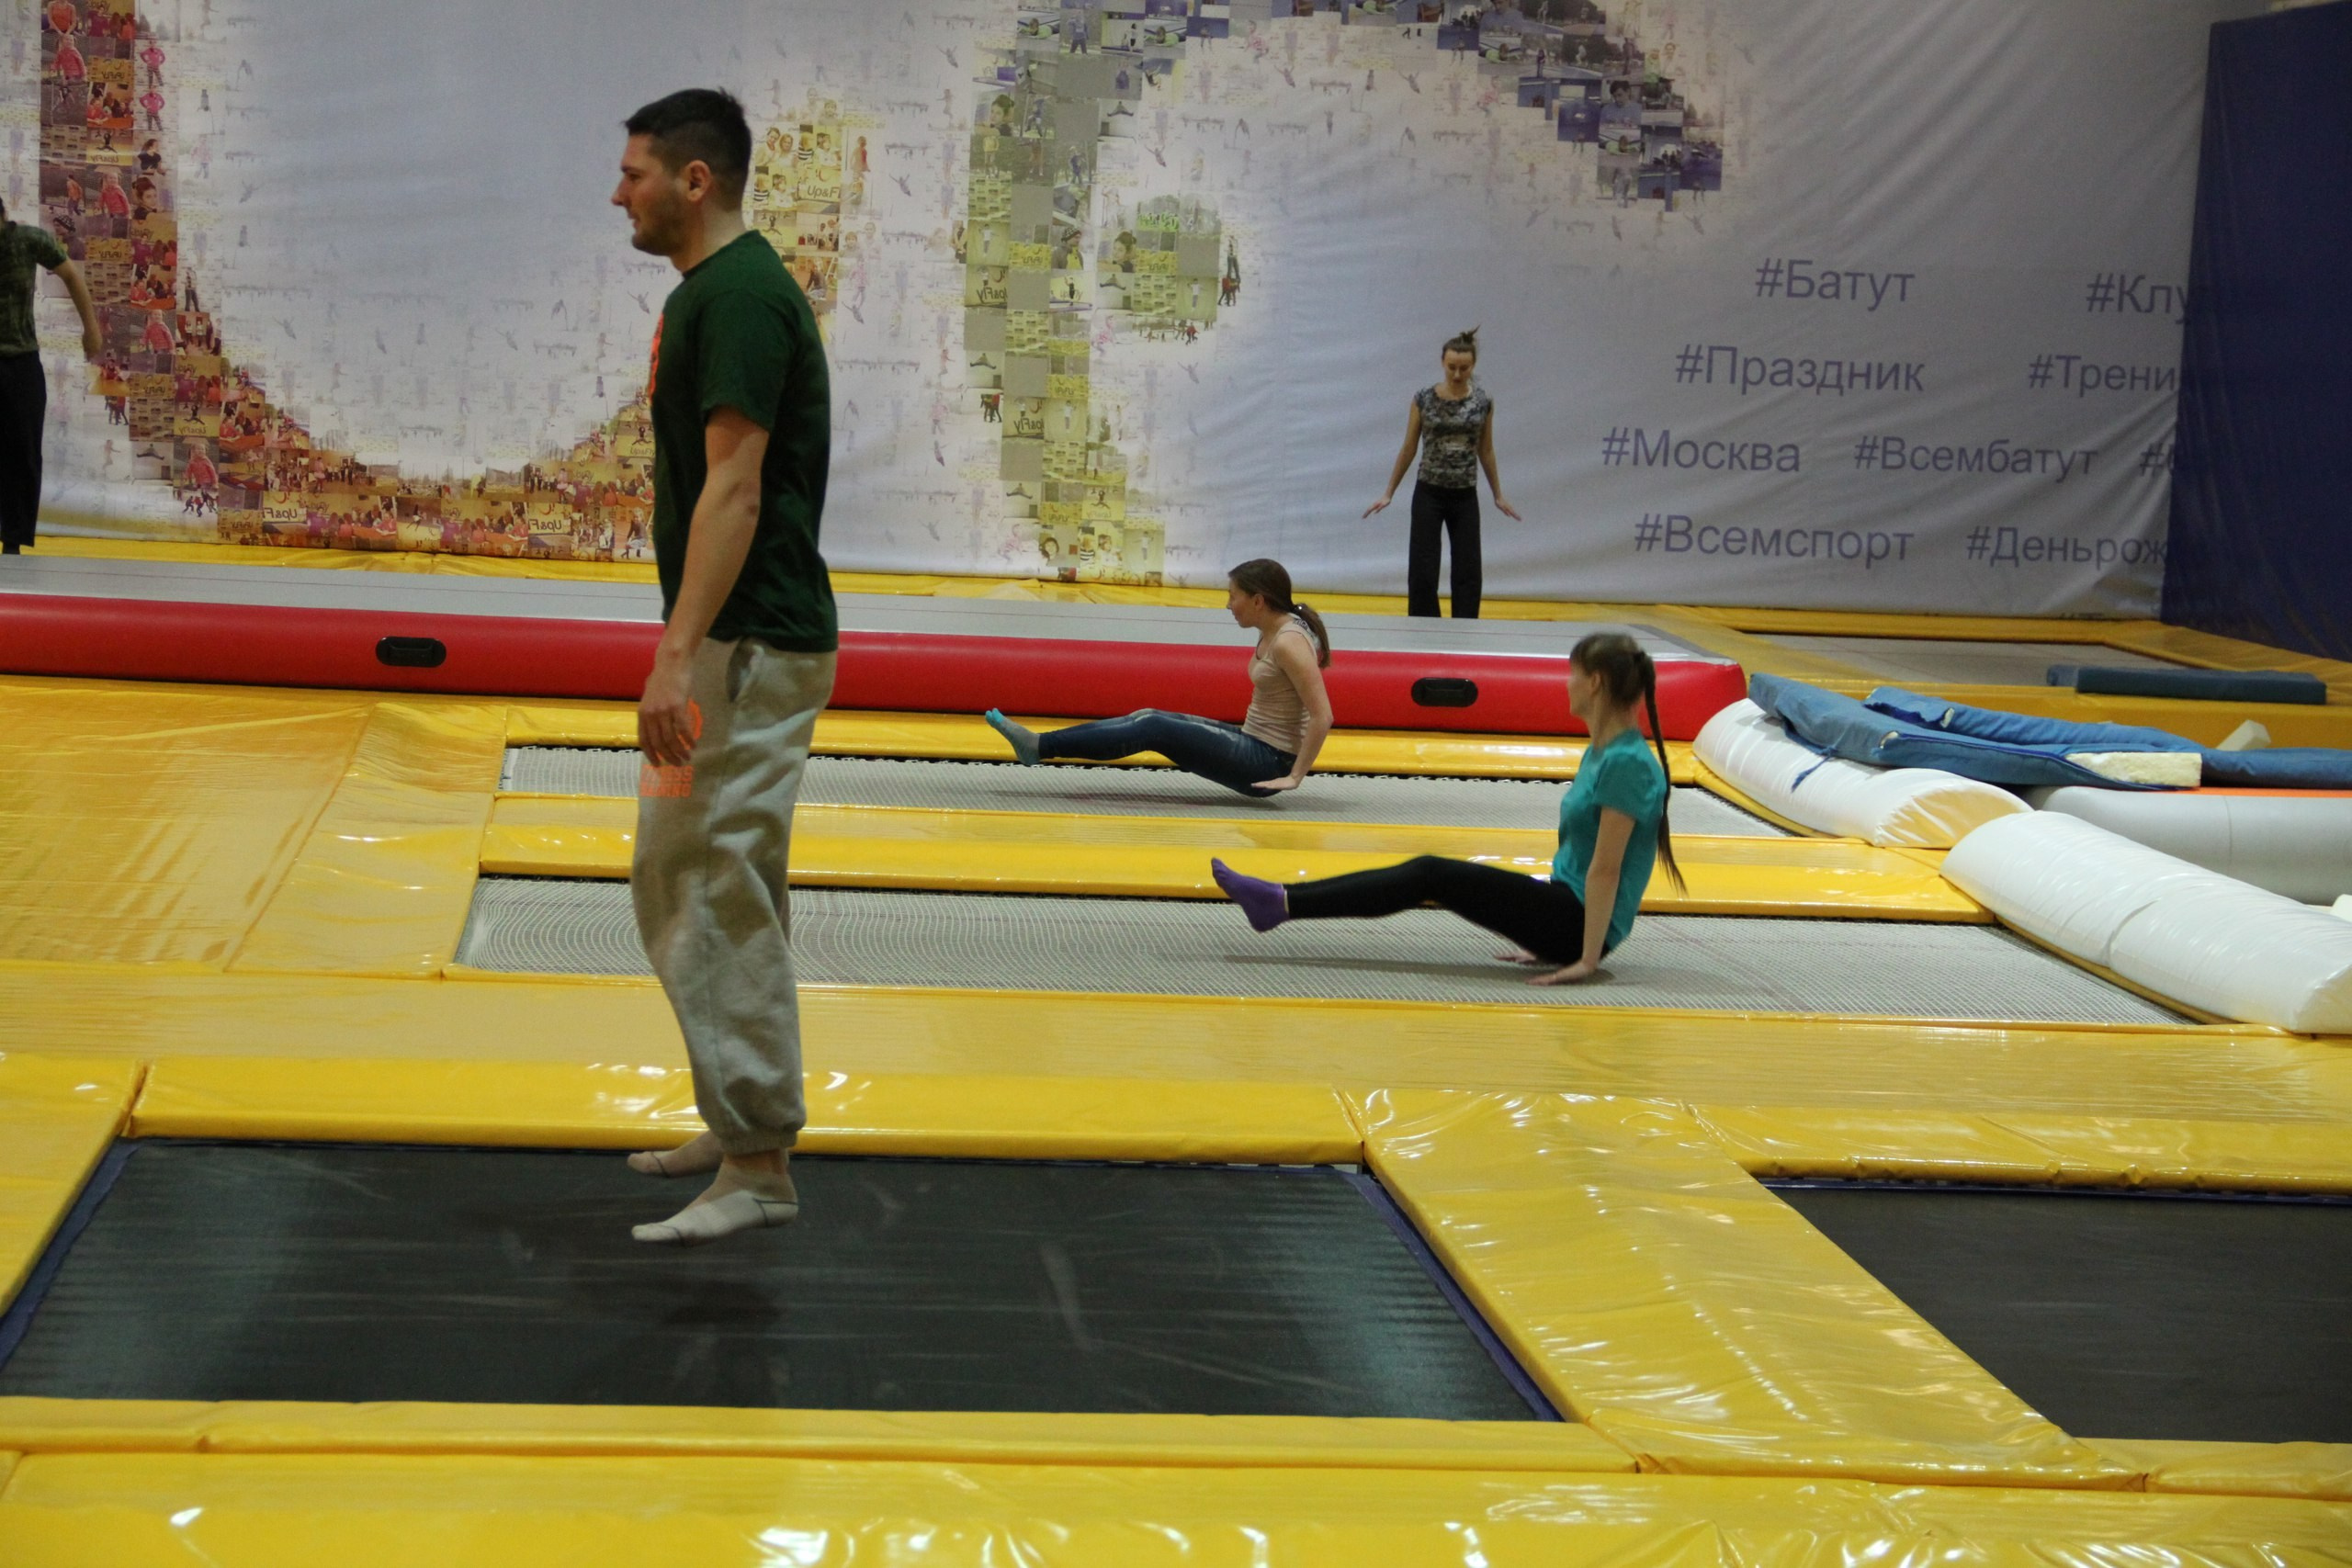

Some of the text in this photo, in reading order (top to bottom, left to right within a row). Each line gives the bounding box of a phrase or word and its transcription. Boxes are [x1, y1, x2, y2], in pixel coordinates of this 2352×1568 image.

[1756, 258, 1915, 312] #Батут
[1676, 344, 2176, 398] #Праздник #Трени
[1602, 427, 1800, 472] #Москва
[1855, 435, 2098, 484] #Всембатут
[1634, 514, 1914, 569] #Всемспорт
